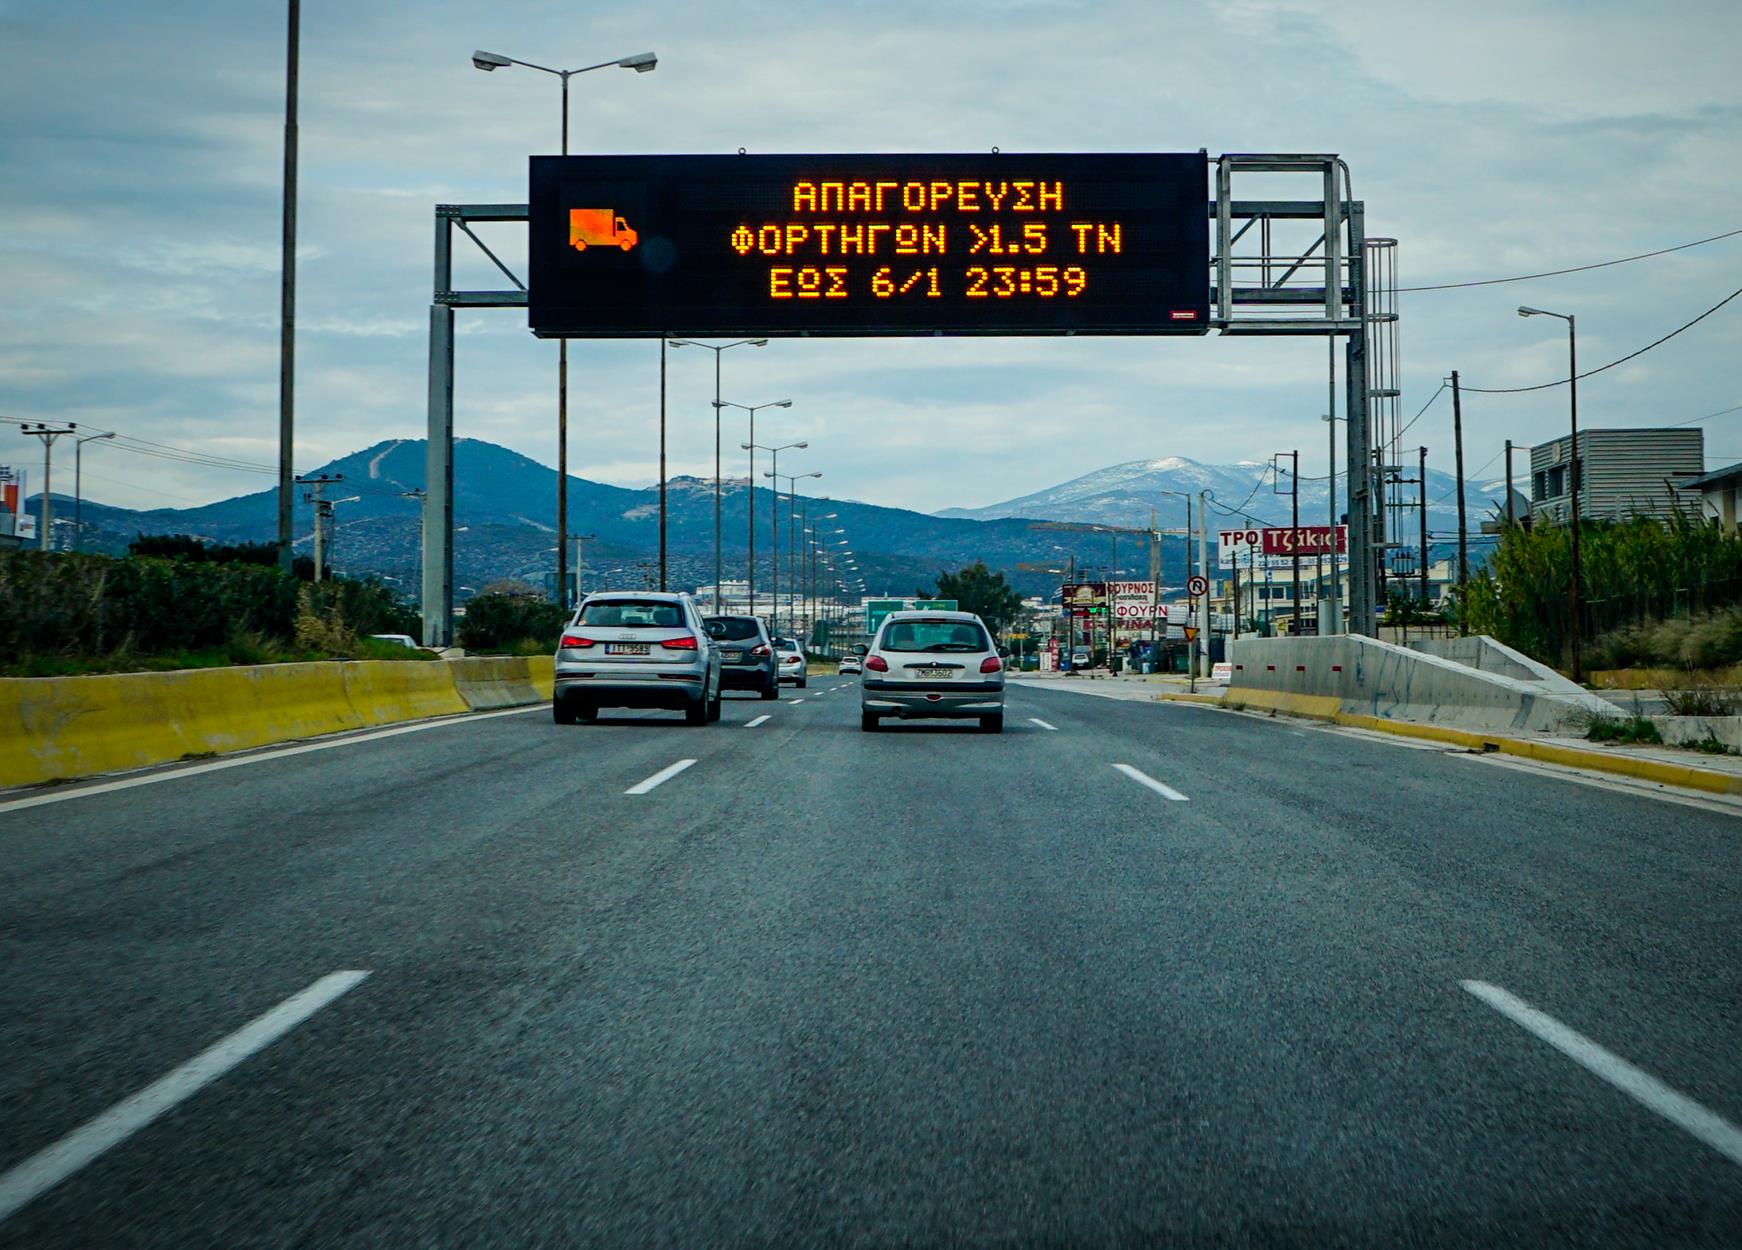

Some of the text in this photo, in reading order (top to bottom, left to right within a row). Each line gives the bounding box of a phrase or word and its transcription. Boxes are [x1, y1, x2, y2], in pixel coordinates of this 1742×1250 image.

[793, 181, 1063, 212] ΑΠΑΓΟΡΕΥΣΗ
[731, 224, 1121, 255] ΦΟΡΤΗΓΩΝ >1.5 ΤΝ
[770, 266, 1086, 297] ΕΩΣ 6/1 23:59
